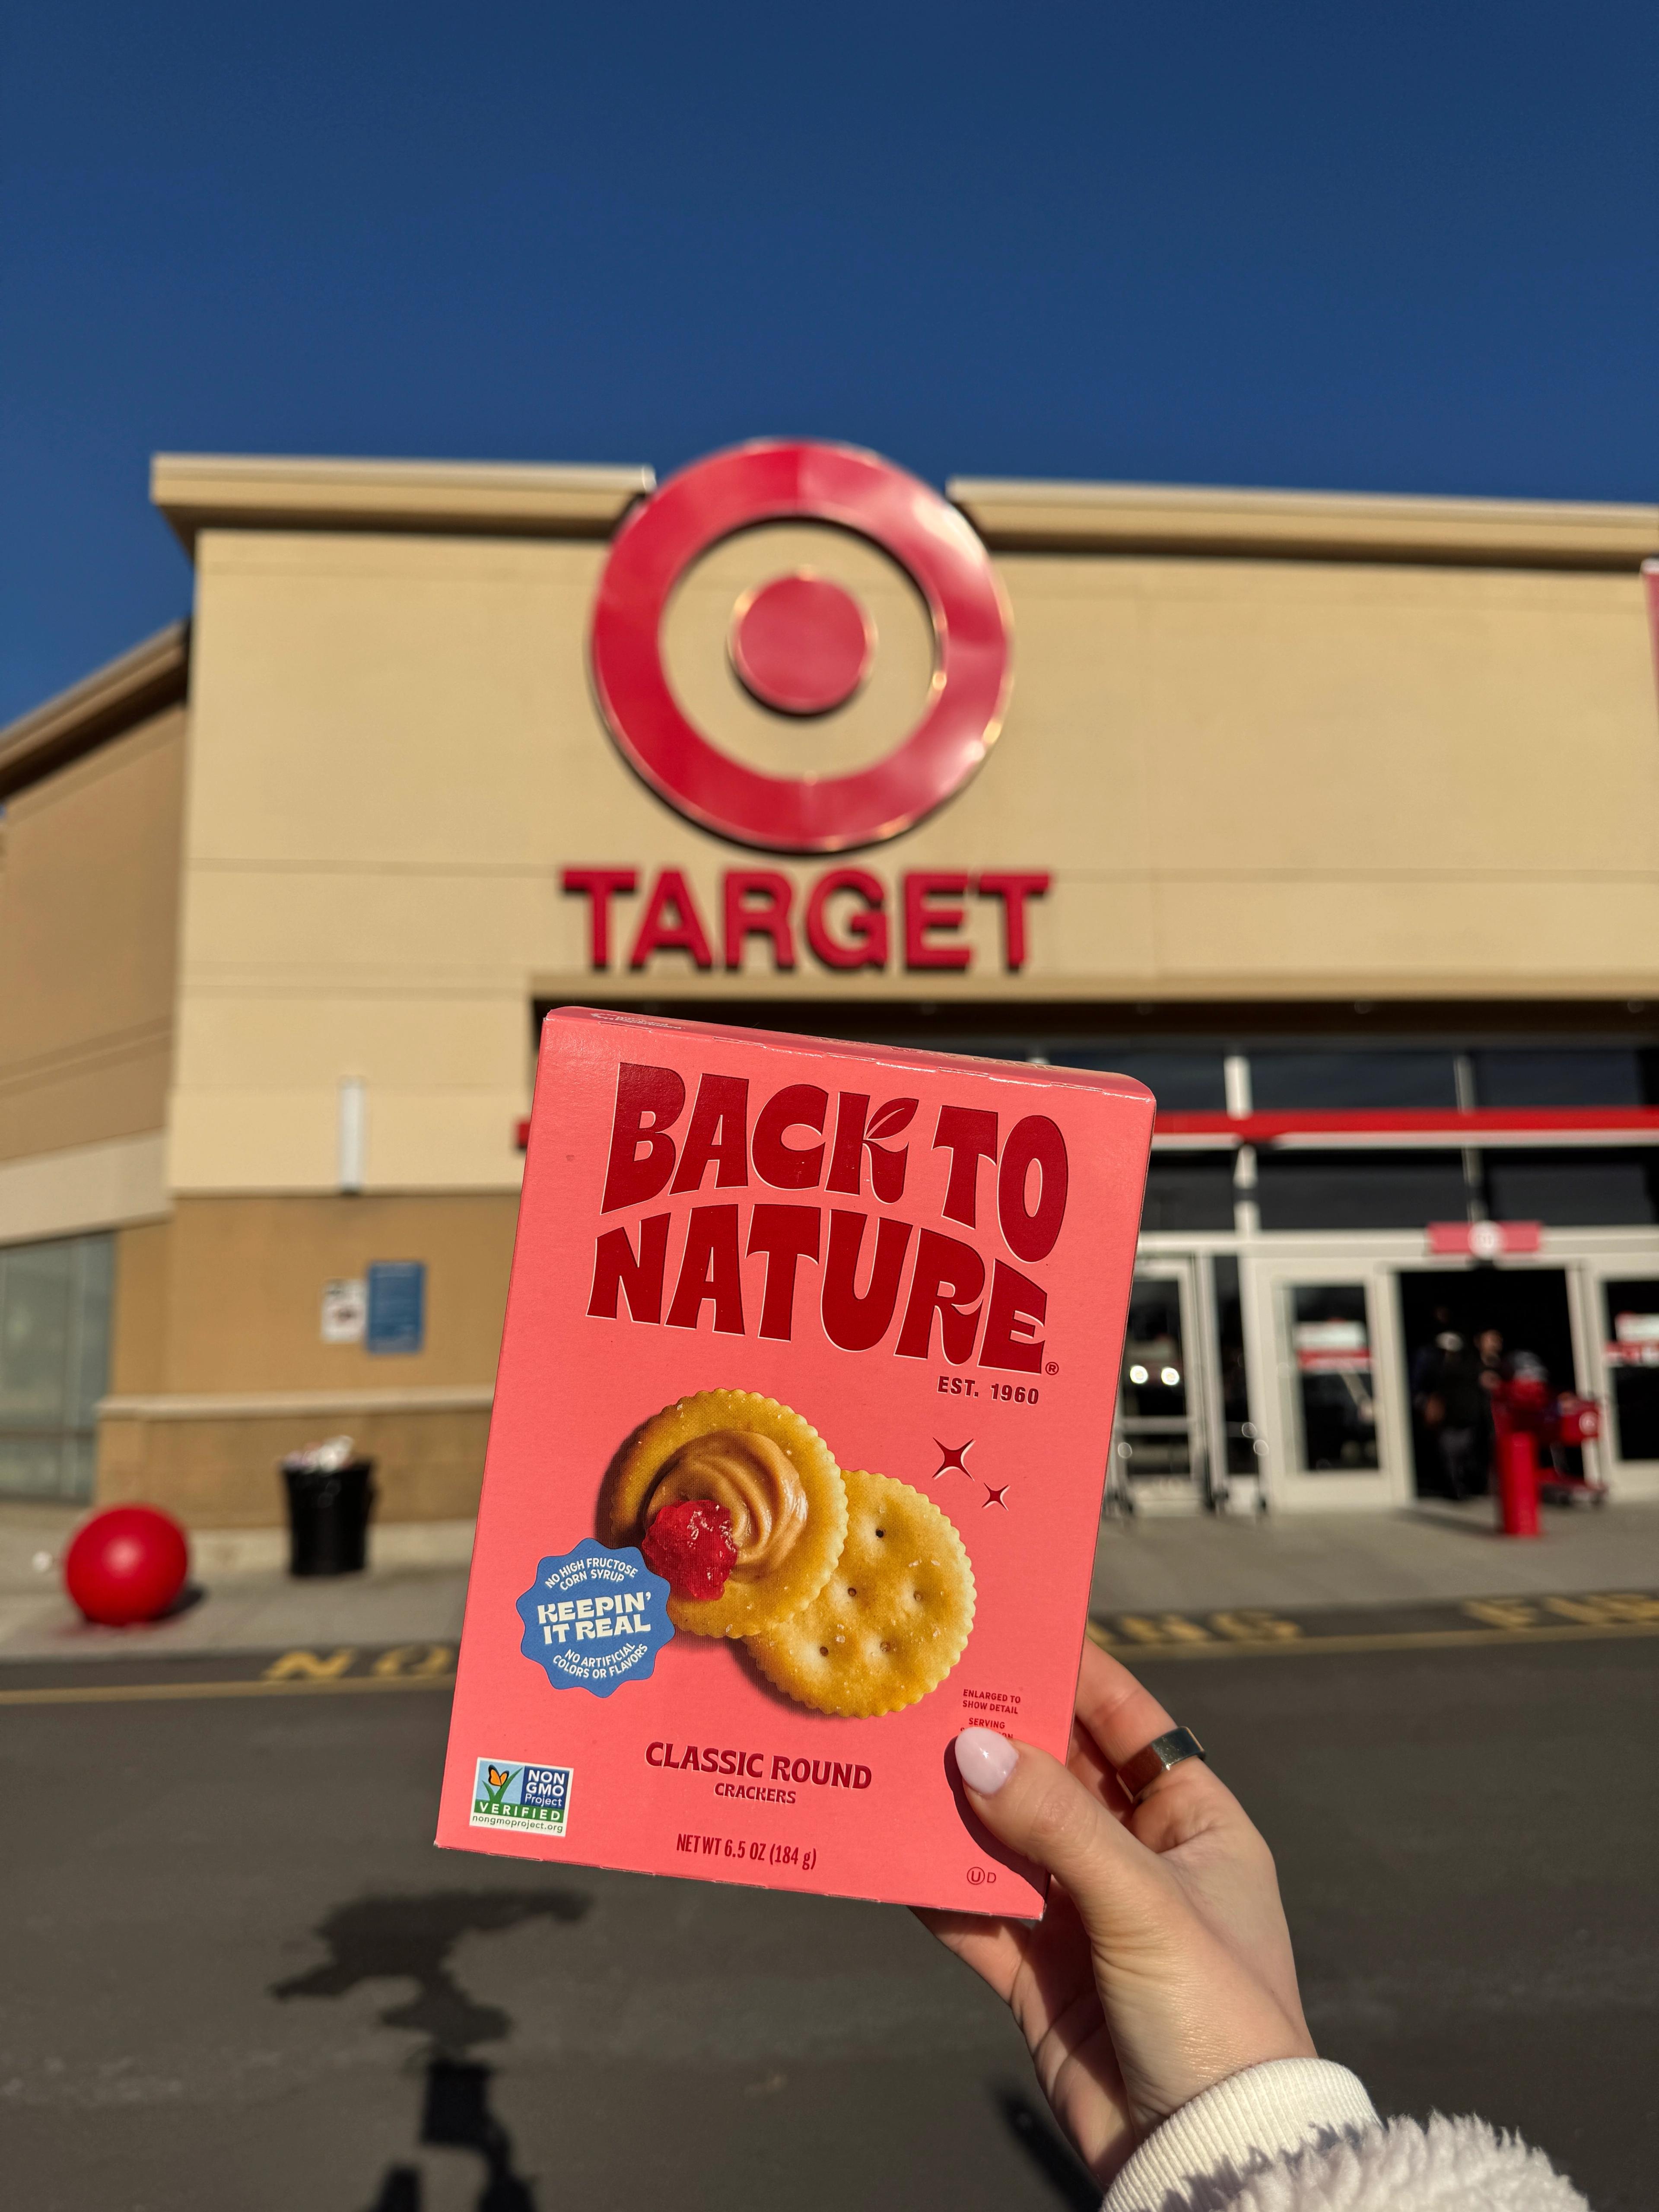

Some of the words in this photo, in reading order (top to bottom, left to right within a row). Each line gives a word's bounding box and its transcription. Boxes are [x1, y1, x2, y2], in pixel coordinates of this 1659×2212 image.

[560, 868, 1052, 971] TARGET
[601, 1062, 919, 1215] BACK
[933, 1105, 1069, 1262] TO
[937, 1376, 979, 1397] EST.
[991, 1383, 1039, 1405] 1960
[545, 1573, 560, 1589] NO
[559, 1560, 585, 1578] HIGH
[586, 1558, 638, 1578] FRUCTOSE
[560, 1573, 587, 1591] CORN
[591, 1569, 624, 1583] SYRUP
[543, 1623, 570, 1644] IT
[575, 1614, 651, 1640] REAL
[553, 1655, 589, 1678] COLORS
[592, 1668, 606, 1678] OR
[609, 1643, 648, 1676] FLAVORS
[565, 1649, 581, 1663] NO
[582, 1643, 635, 1667] ARTIFICIAL
[963, 1689, 1007, 1701] ENLARGED
[1010, 1695, 1021, 1703] TO
[963, 1700, 988, 1710] SHOW
[989, 1703, 1018, 1714] DETAIL
[969, 1717, 1005, 1729] SERVING
[645, 1742, 764, 1778] CLASSIC
[771, 1755, 872, 1789] ROUND
[528, 1770, 565, 1784] NON
[525, 1793, 562, 1807] Project
[526, 1782, 564, 1797] GMO
[715, 1783, 796, 1804] CRACKERS
[480, 1802, 560, 1821] VERIFIED
[473, 1815, 563, 1834] nongmoproject.org
[677, 1834, 701, 1853] NET
[702, 1836, 721, 1855] WT
[725, 1839, 745, 1858] 6.5
[750, 1842, 766, 1861] OZ
[769, 1843, 799, 1865] (184
[802, 1848, 817, 1870] g)
